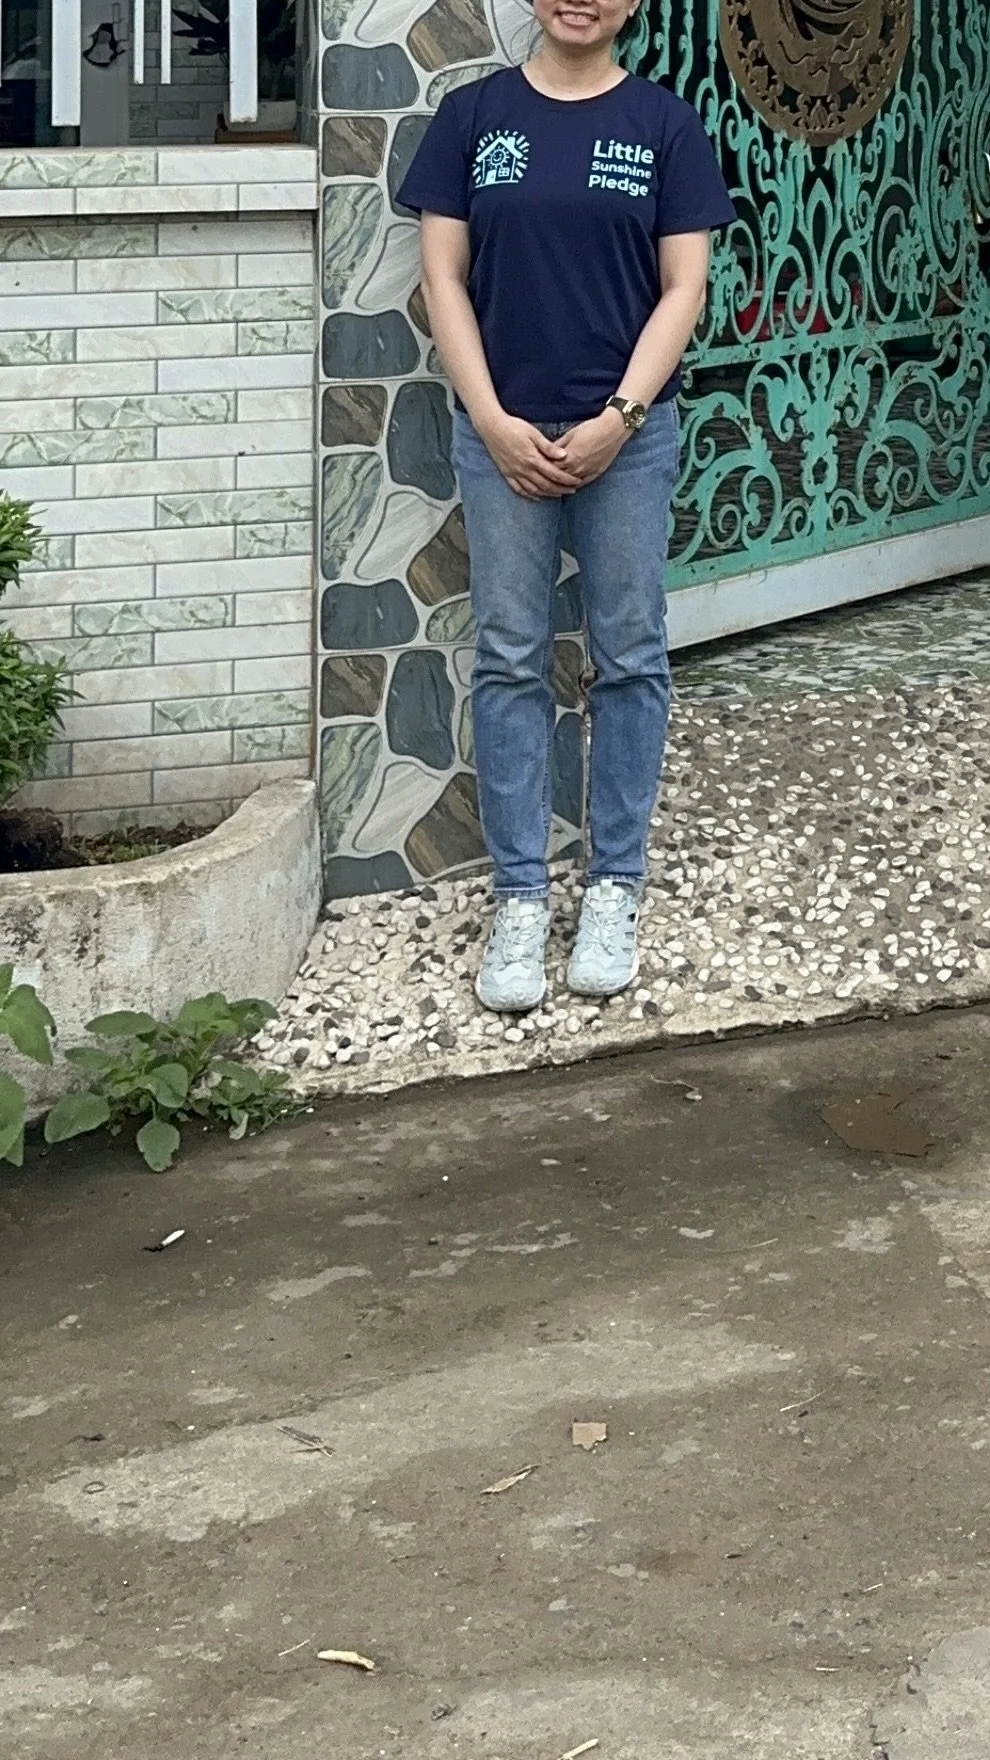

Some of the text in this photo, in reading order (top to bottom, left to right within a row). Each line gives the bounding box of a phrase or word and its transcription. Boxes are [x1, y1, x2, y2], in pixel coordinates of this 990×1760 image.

[593, 139, 655, 164] Little
[591, 160, 653, 180] Sunshine
[588, 174, 649, 197] Pledge
